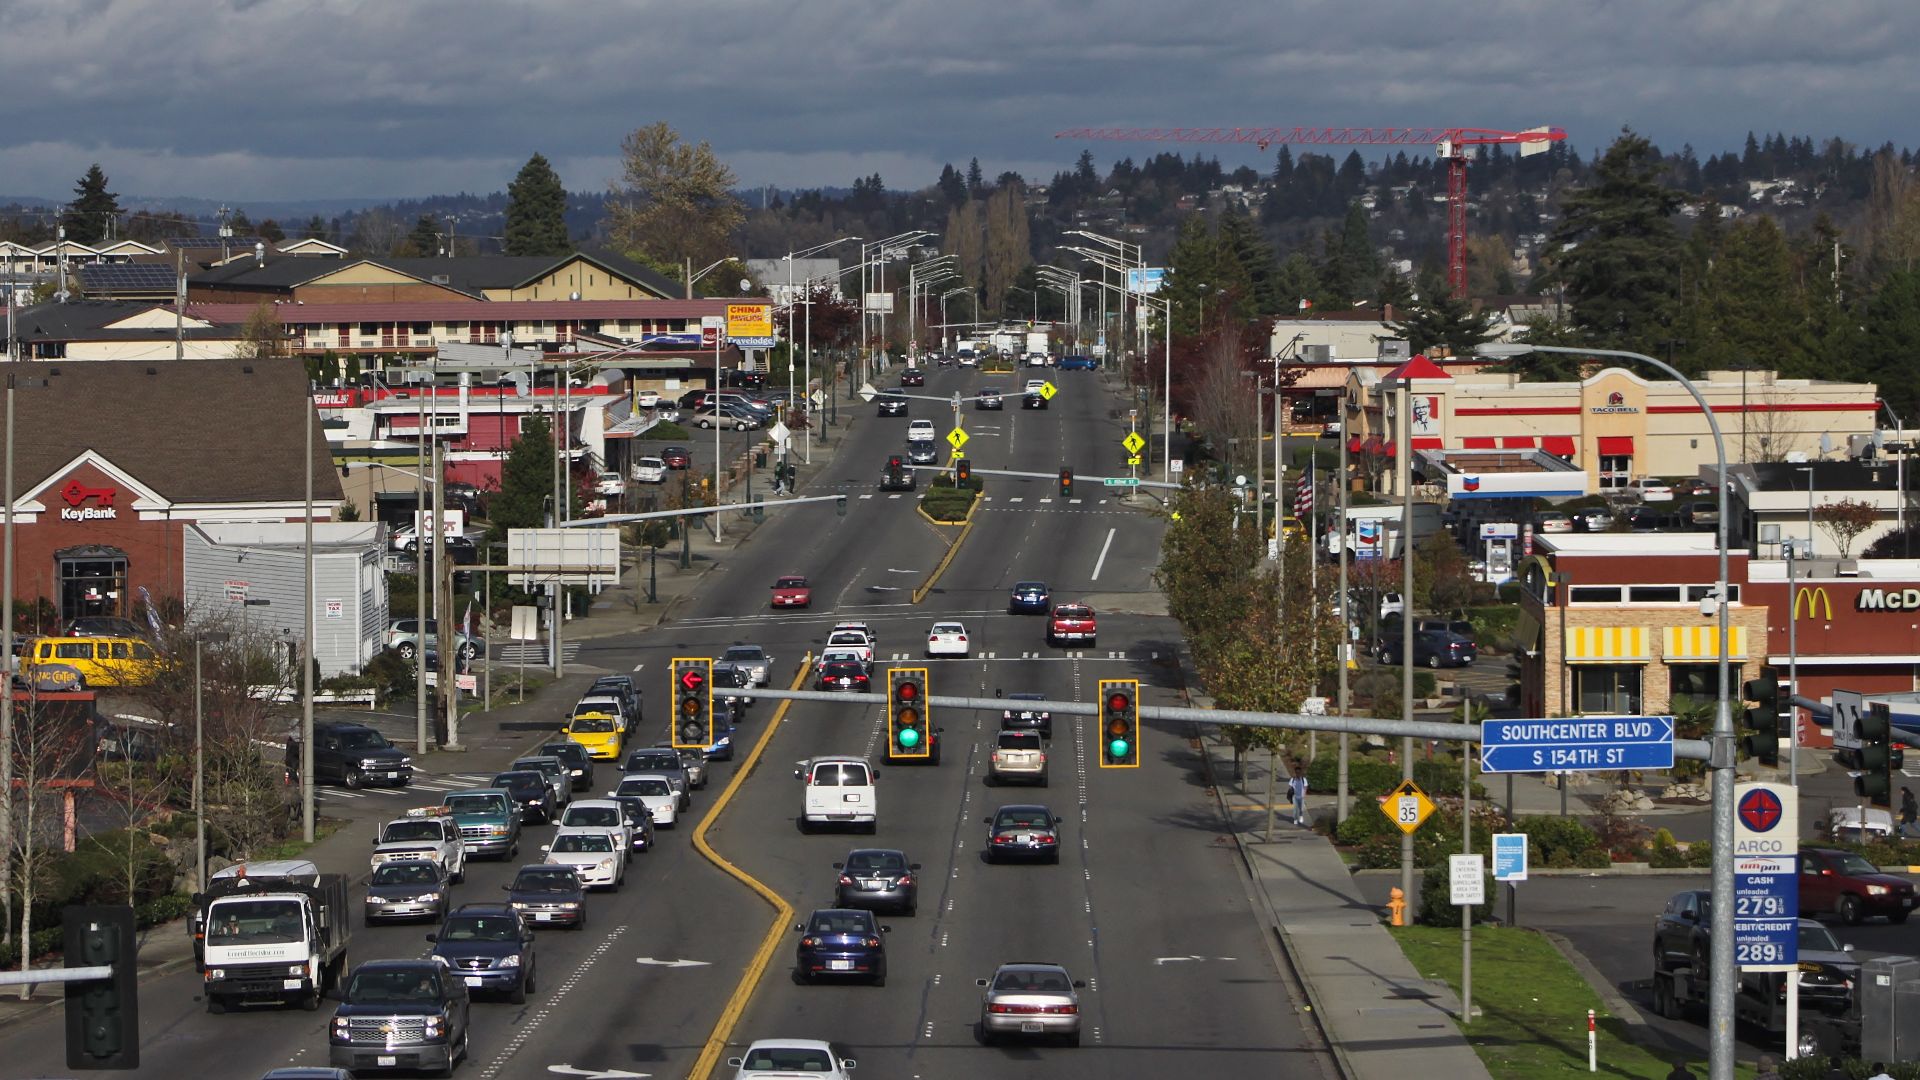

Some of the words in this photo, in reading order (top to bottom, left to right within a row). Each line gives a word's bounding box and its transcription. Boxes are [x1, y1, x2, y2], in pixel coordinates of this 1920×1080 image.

[730, 314, 763, 322] PAVILION
[726, 336, 773, 345] Travelodge
[61, 507, 117, 522] KeyBank
[1859, 588, 1920, 608] McD
[52, 670, 77, 685] CENTER
[1501, 723, 1608, 741] SOUTHCENTER
[1614, 722, 1652, 739] BLVD
[1532, 750, 1543, 765] S
[1551, 749, 1598, 765] 154TH
[1606, 748, 1625, 763] ST
[1400, 807, 1416, 822] 35
[1737, 840, 1783, 853] ARCO
[1740, 863, 1781, 872] ampm
[1747, 876, 1774, 885] CASH
[1737, 897, 1778, 915] 279
[1737, 944, 1776, 962] 289
